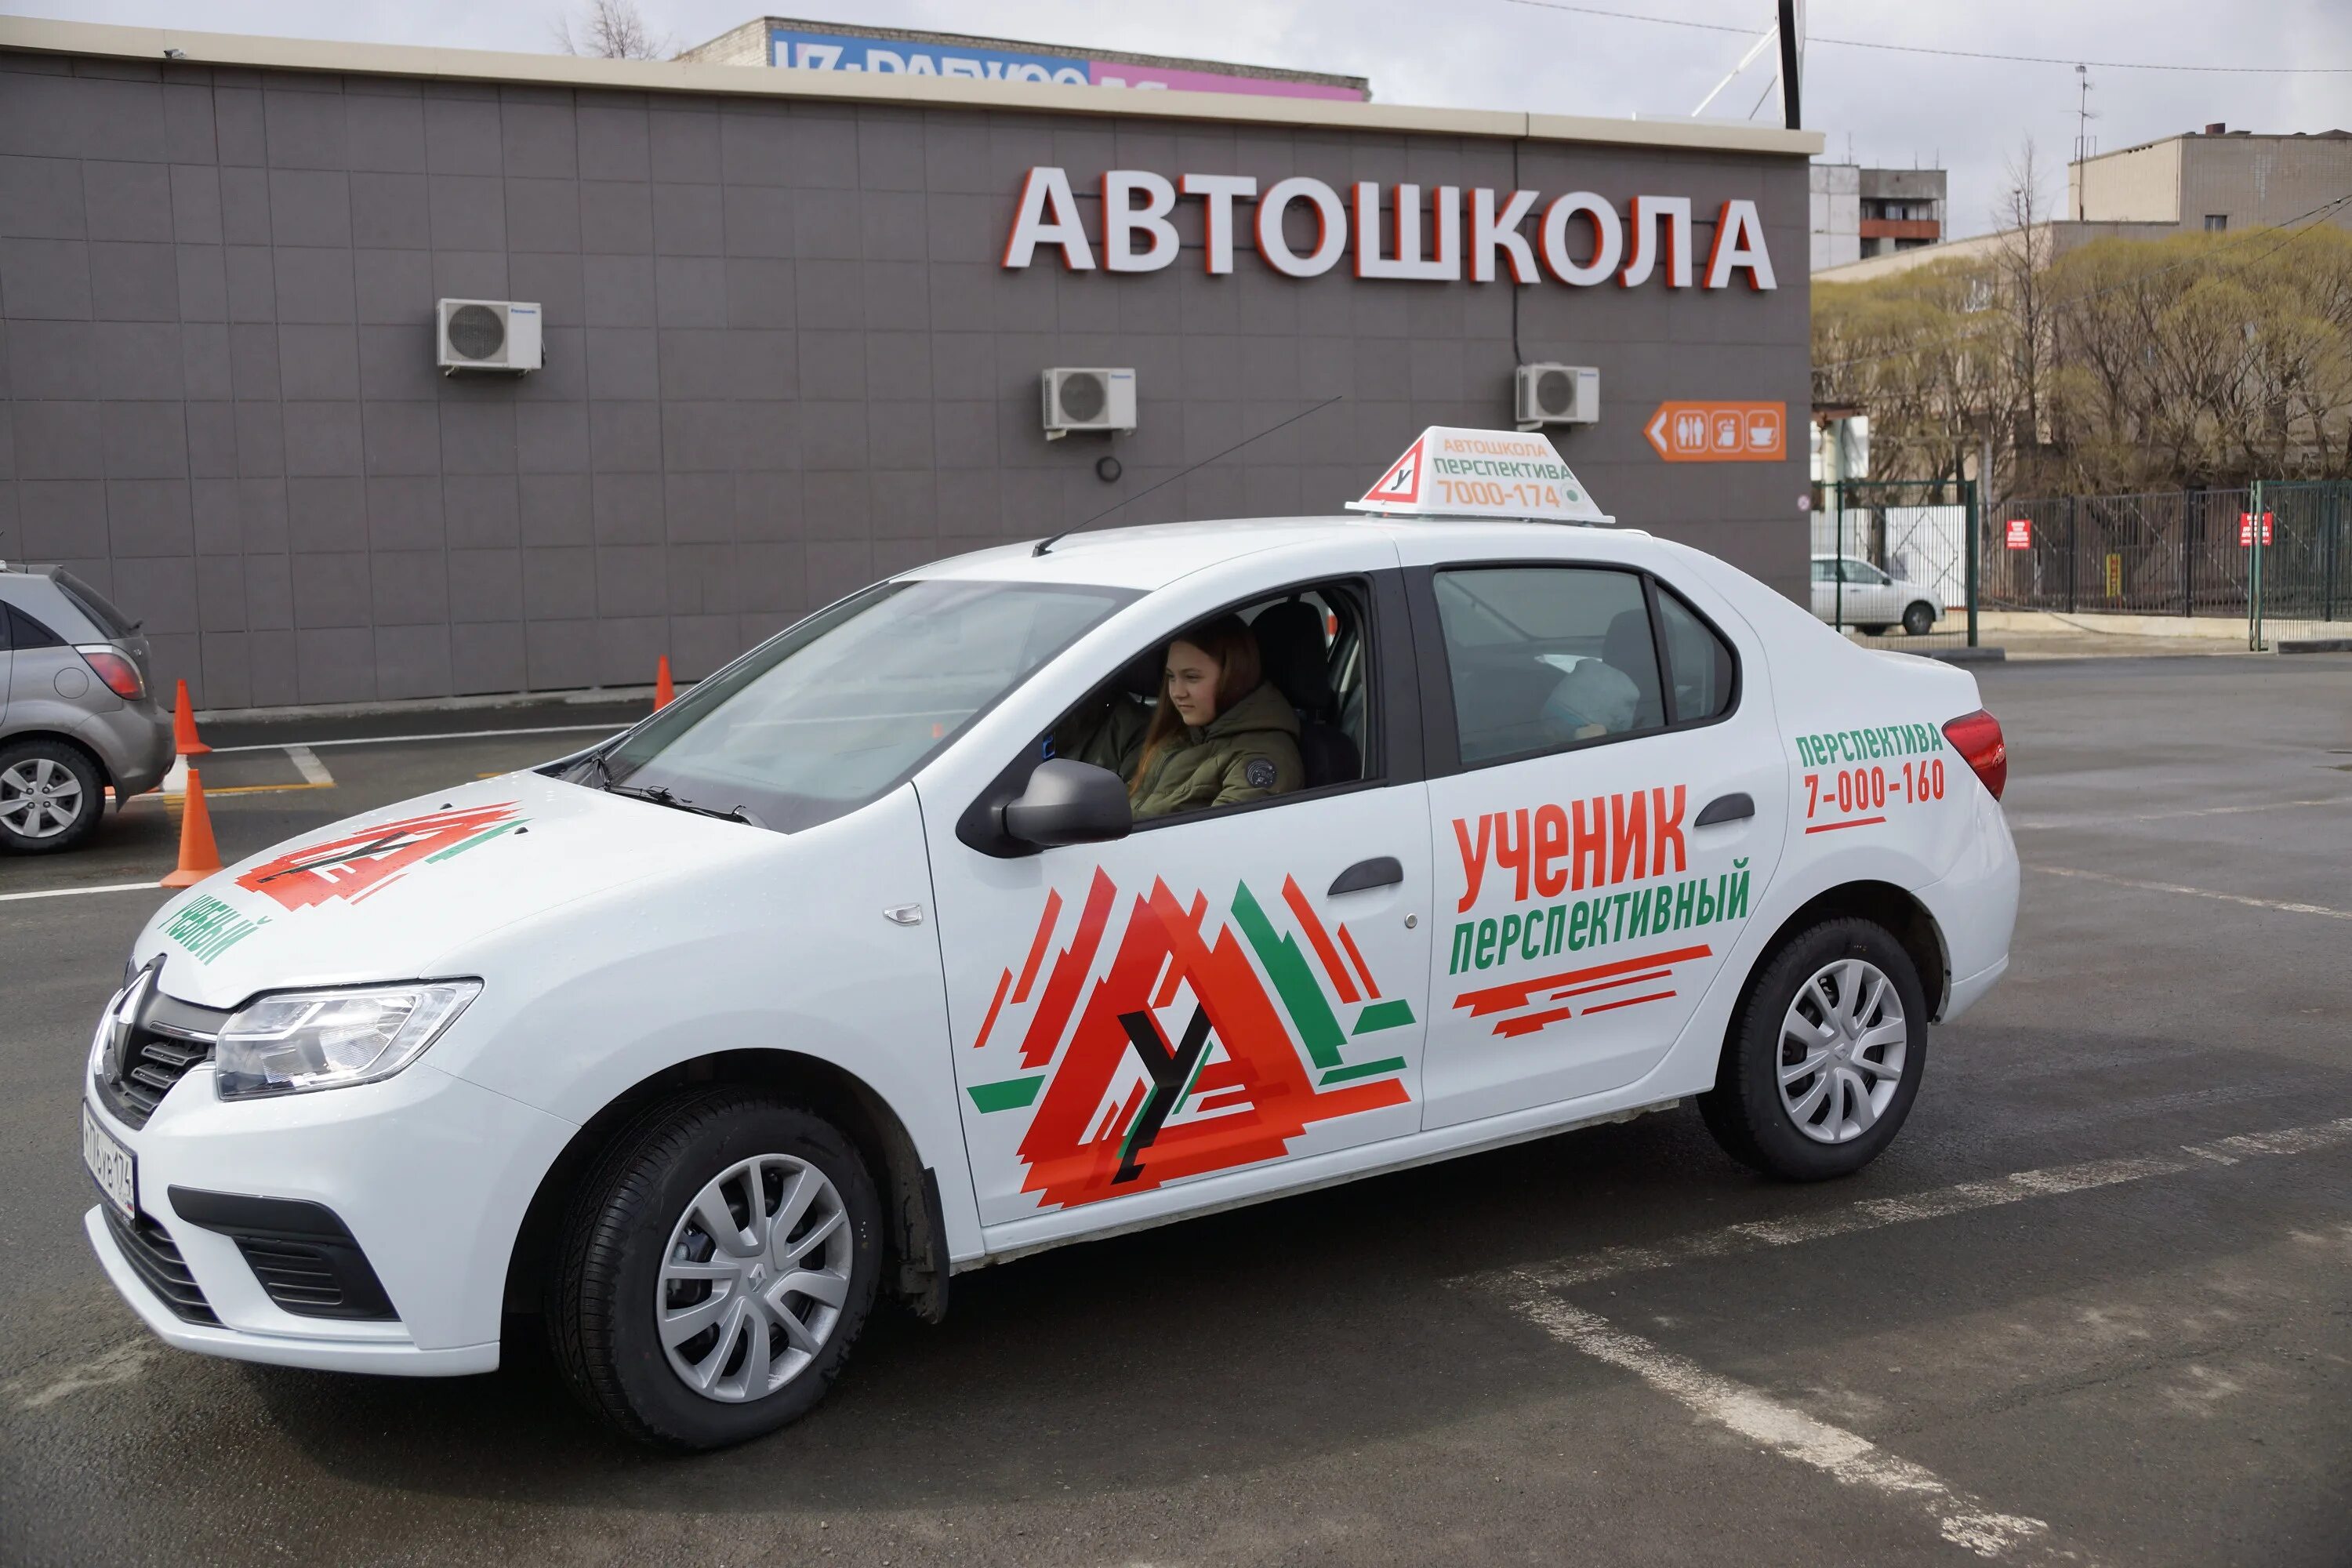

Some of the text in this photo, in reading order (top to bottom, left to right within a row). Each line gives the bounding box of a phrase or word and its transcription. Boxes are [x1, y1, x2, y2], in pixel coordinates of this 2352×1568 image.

[1002, 165, 1778, 291] АВТОШКОЛА
[1432, 457, 1573, 481] ПЕРСПЕКТИВА
[1443, 438, 1548, 458] АВТОШКОЛА
[1391, 469, 1412, 491] У
[1437, 480, 1560, 508] 7000-174
[1795, 722, 1944, 768] ПЕРСПЕКТИВА
[1804, 758, 1944, 818] 7-000-160
[1452, 784, 1686, 914] УЧЕНИК
[1449, 857, 1751, 975] ПЕРСПЕКТИВНЫЙ
